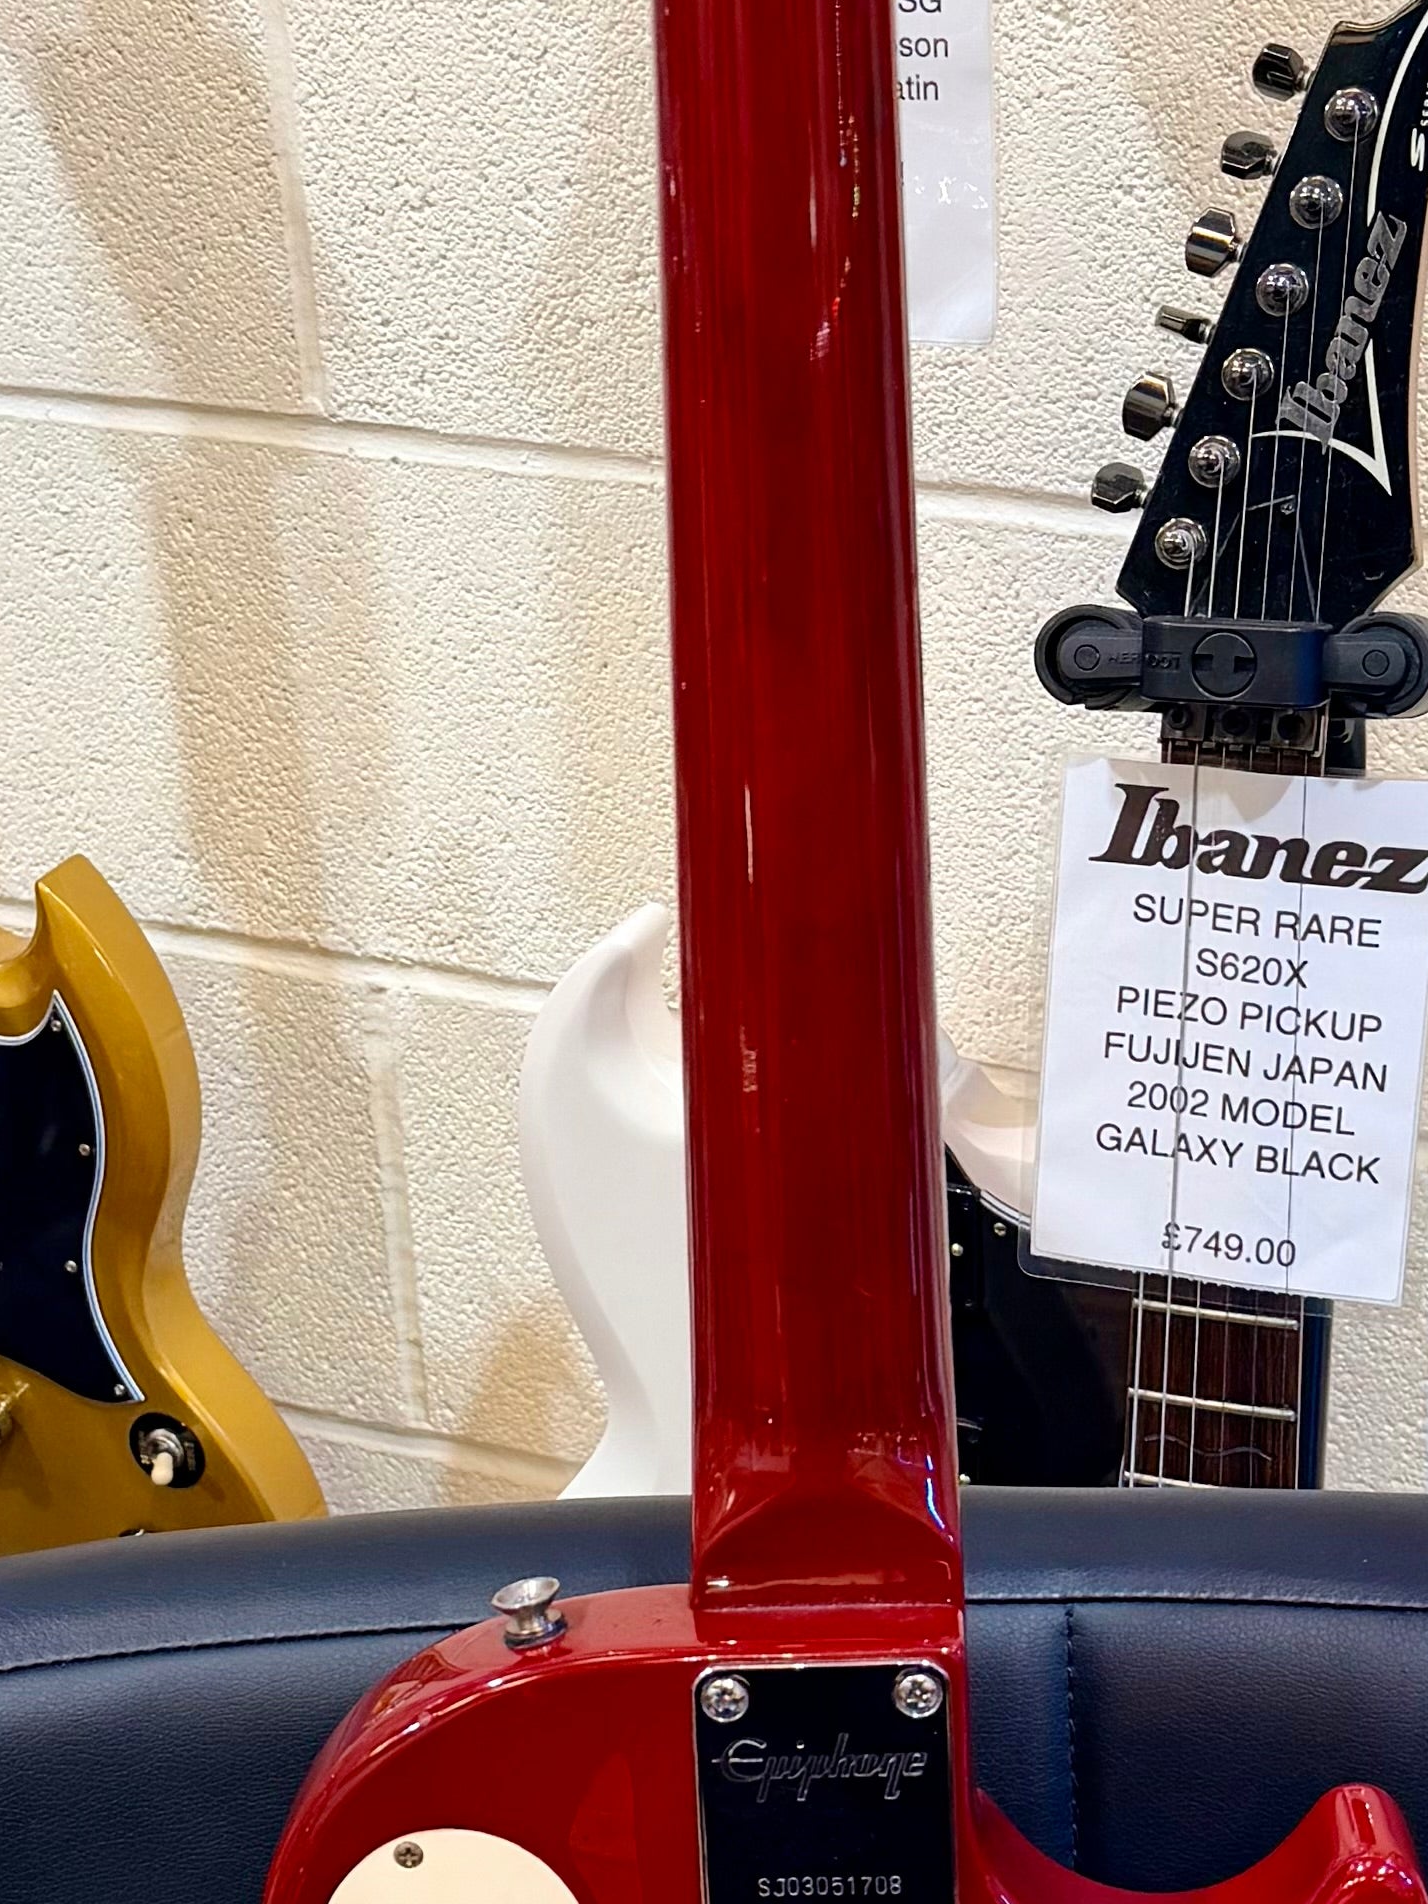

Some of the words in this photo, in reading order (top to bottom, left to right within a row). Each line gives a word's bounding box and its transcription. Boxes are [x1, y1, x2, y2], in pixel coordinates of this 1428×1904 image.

[898, 37, 949, 58] son
[896, 74, 939, 101] atin
[1275, 211, 1408, 456] Ibanez
[1132, 894, 1261, 937] SUPER
[1273, 910, 1382, 949] RARE
[1195, 948, 1309, 989] S620X
[1116, 985, 1228, 1026] PIEZO
[1239, 1000, 1383, 1044] PICKUP
[1103, 1030, 1252, 1079] FUJIJEN
[1262, 1052, 1388, 1093] JAPAN
[1126, 1080, 1210, 1118] 2002
[1220, 1092, 1356, 1137] MODEL
[1095, 1122, 1245, 1169] GALAXY
[1255, 1141, 1382, 1185] BLACK
[1160, 1220, 1298, 1268] £749.00
[711, 1732, 928, 1803] Epiphone
[758, 1874, 903, 1898] SJ03051708
